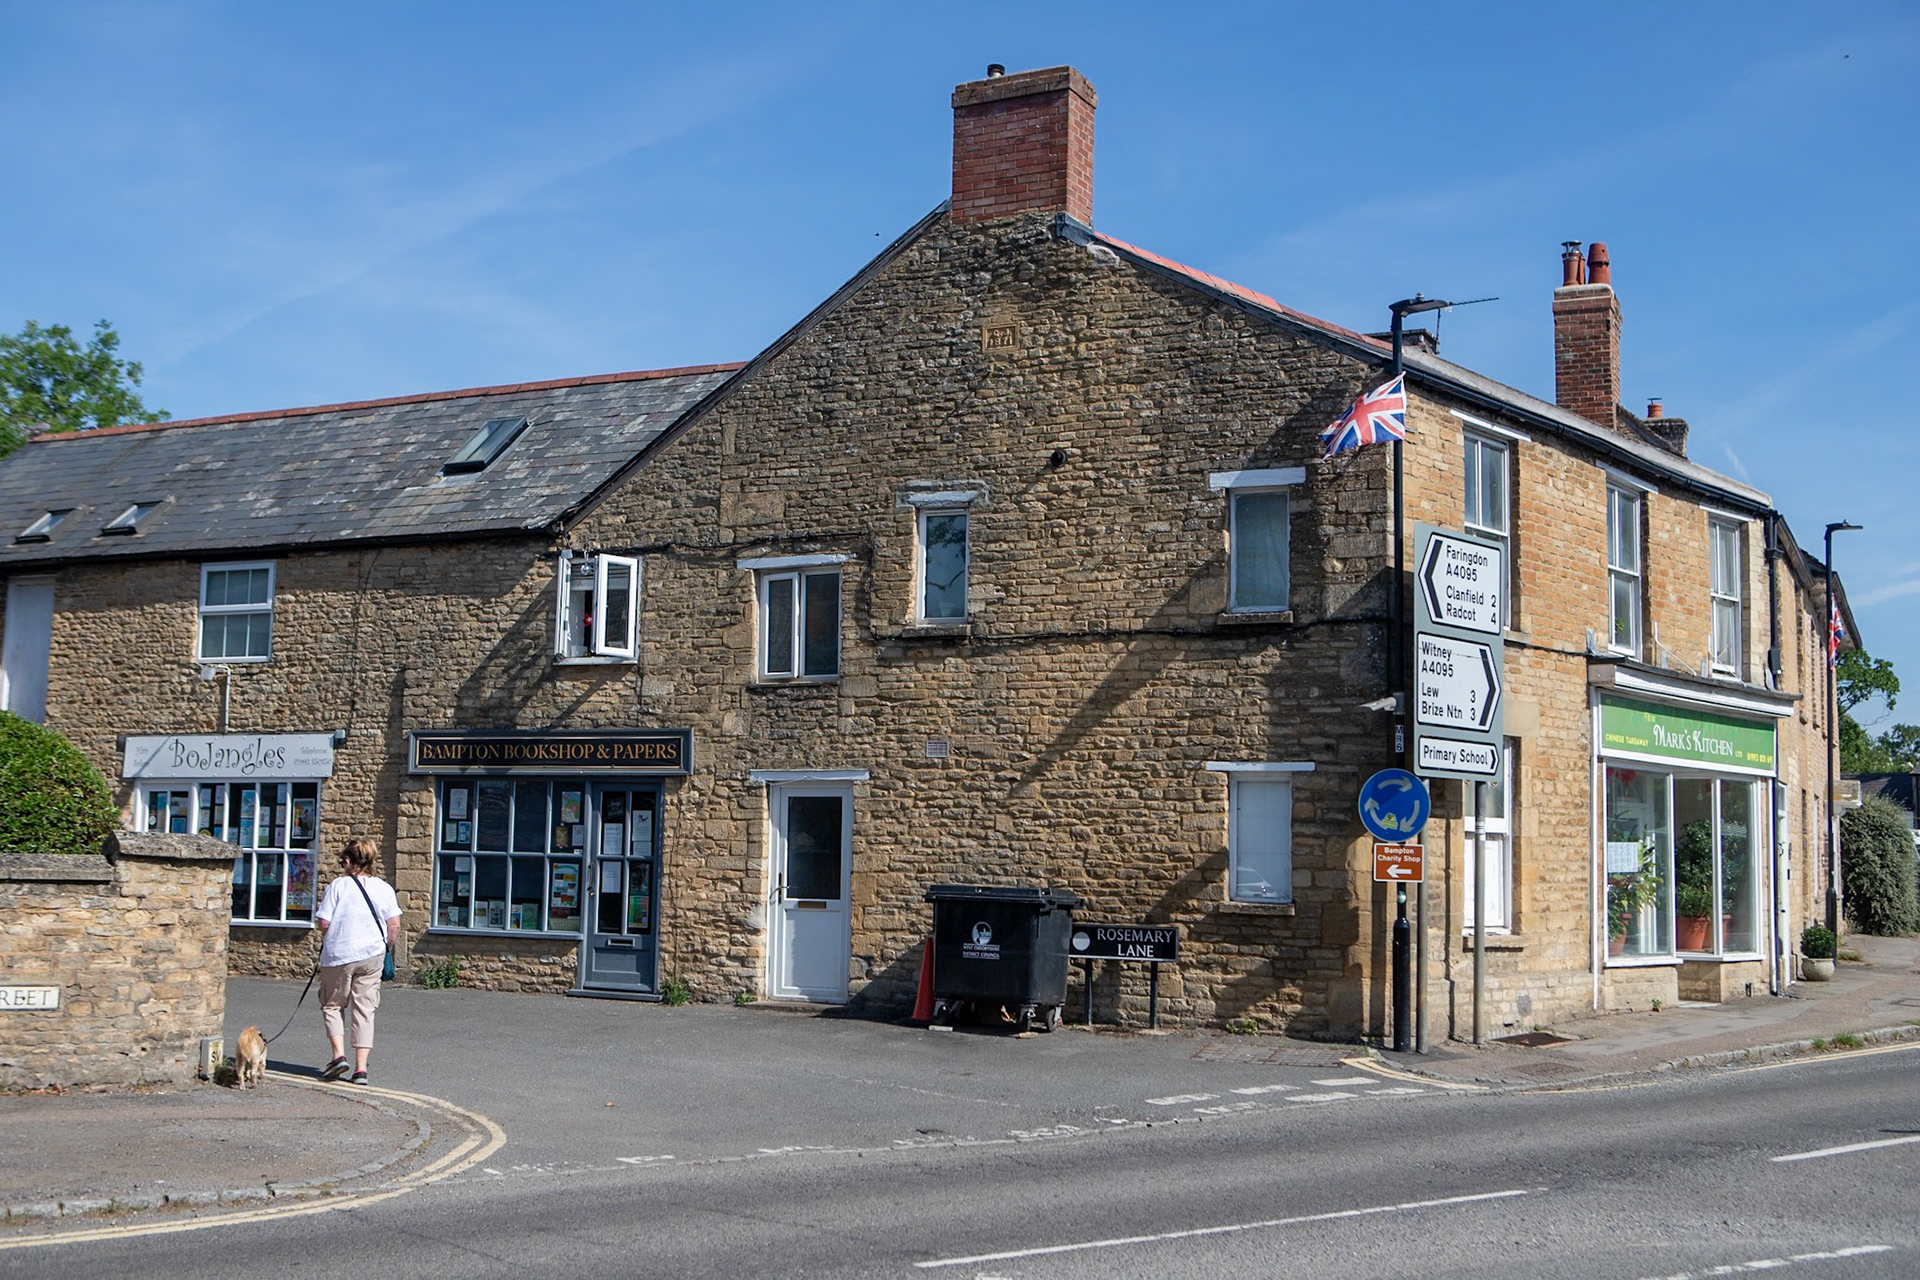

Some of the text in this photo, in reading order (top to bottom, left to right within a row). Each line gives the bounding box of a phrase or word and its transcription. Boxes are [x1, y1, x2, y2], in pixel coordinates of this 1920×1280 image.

[1446, 545, 1488, 566] Faringdon
[1446, 563, 1478, 582] A4095
[1446, 585, 1497, 608] Clanfield 2
[1446, 603, 1497, 625] Radcot 4
[1421, 641, 1452, 661] Witney
[1421, 660, 1454, 678] A4095
[1421, 682, 1476, 703] Lew 3
[1421, 701, 1476, 721] Brize Ntn 3
[423, 743, 677, 759] BAMPTON BOOKSHOP & PAPERS
[1423, 745, 1488, 765] Primary School
[1378, 855, 1421, 863] Charity Shop
[1097, 928, 1173, 943] ROSEMARY
[1117, 943, 1154, 957] LANE
